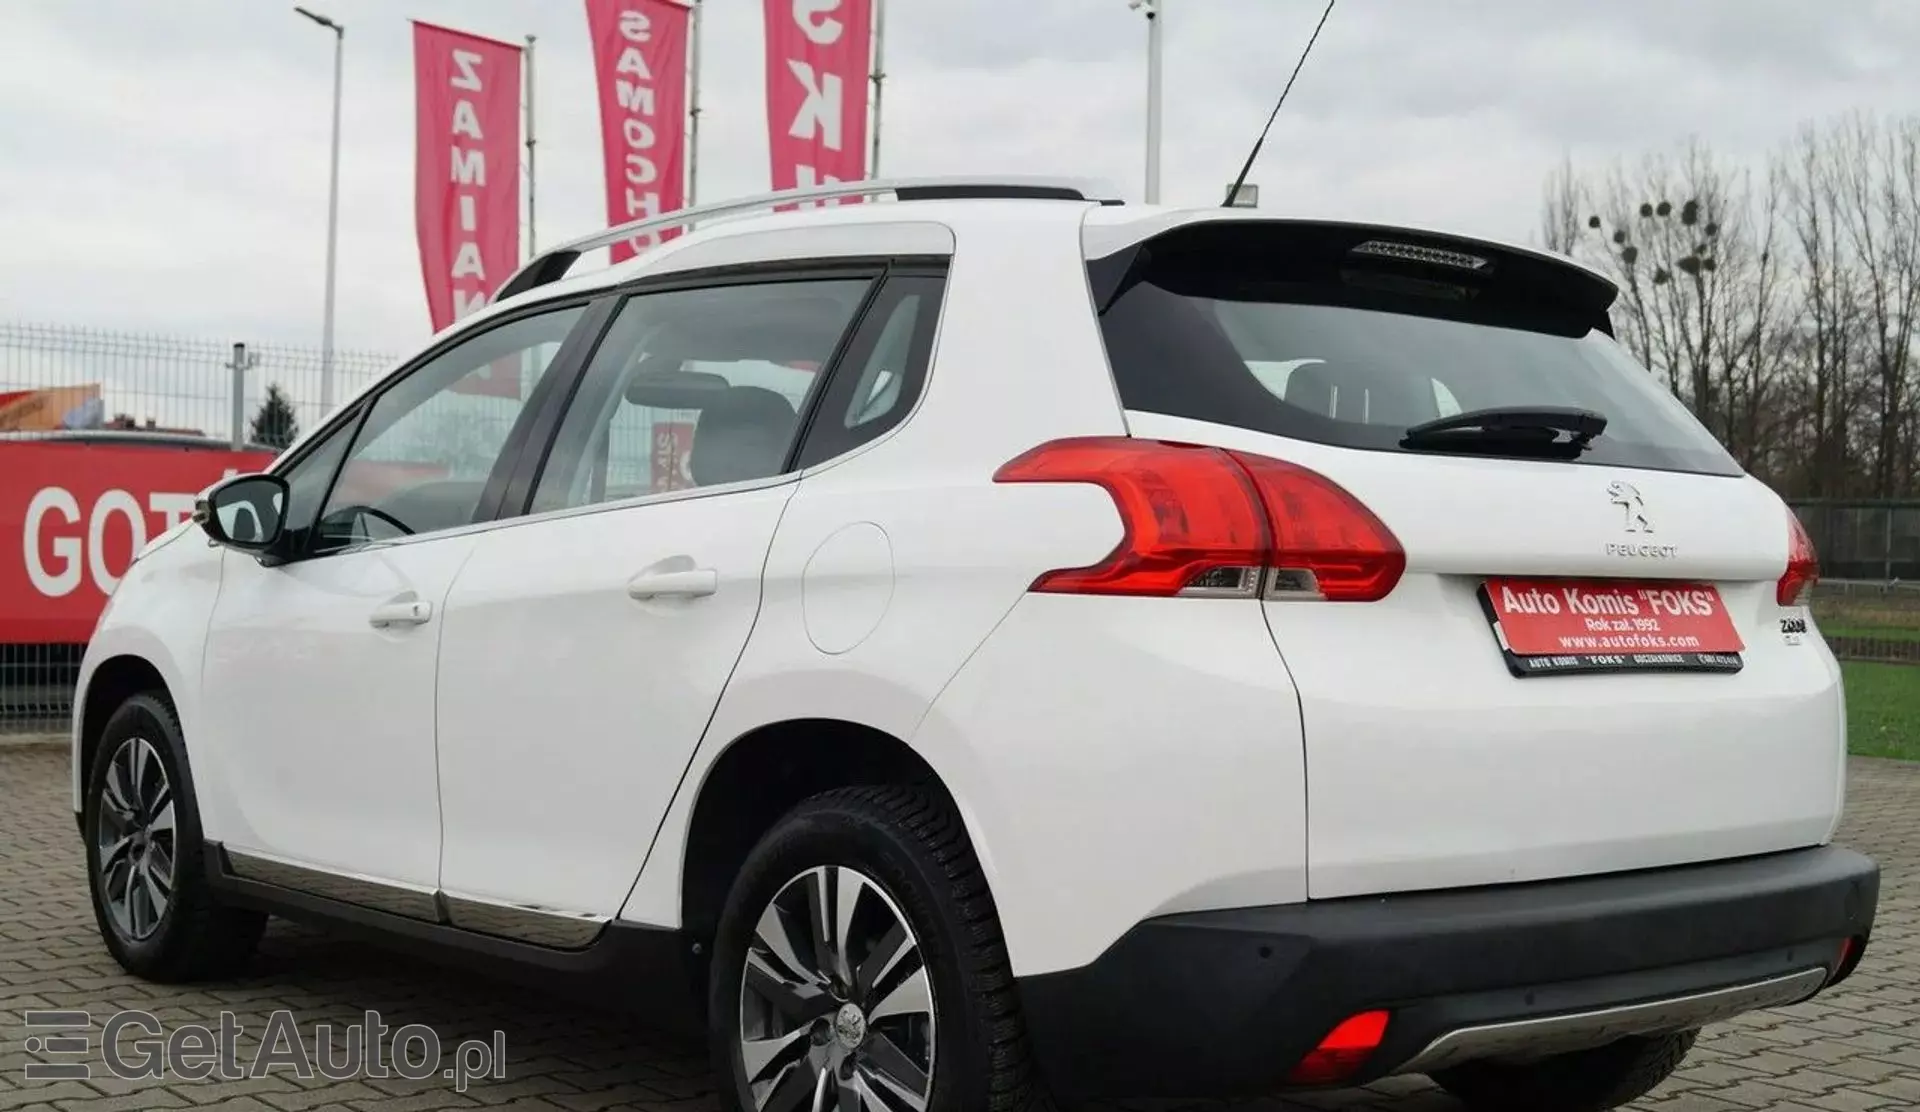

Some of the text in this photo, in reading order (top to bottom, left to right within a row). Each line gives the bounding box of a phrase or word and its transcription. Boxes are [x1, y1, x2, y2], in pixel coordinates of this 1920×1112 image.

[24, 468, 237, 597] GOT
[1604, 543, 1679, 558] PEUGEOT
[1502, 586, 1715, 617] Auto Komis "FOKS"
[1585, 618, 1611, 632] Rok
[1633, 618, 1661, 632] 1992
[1559, 633, 1700, 649] www.autofoks.com
